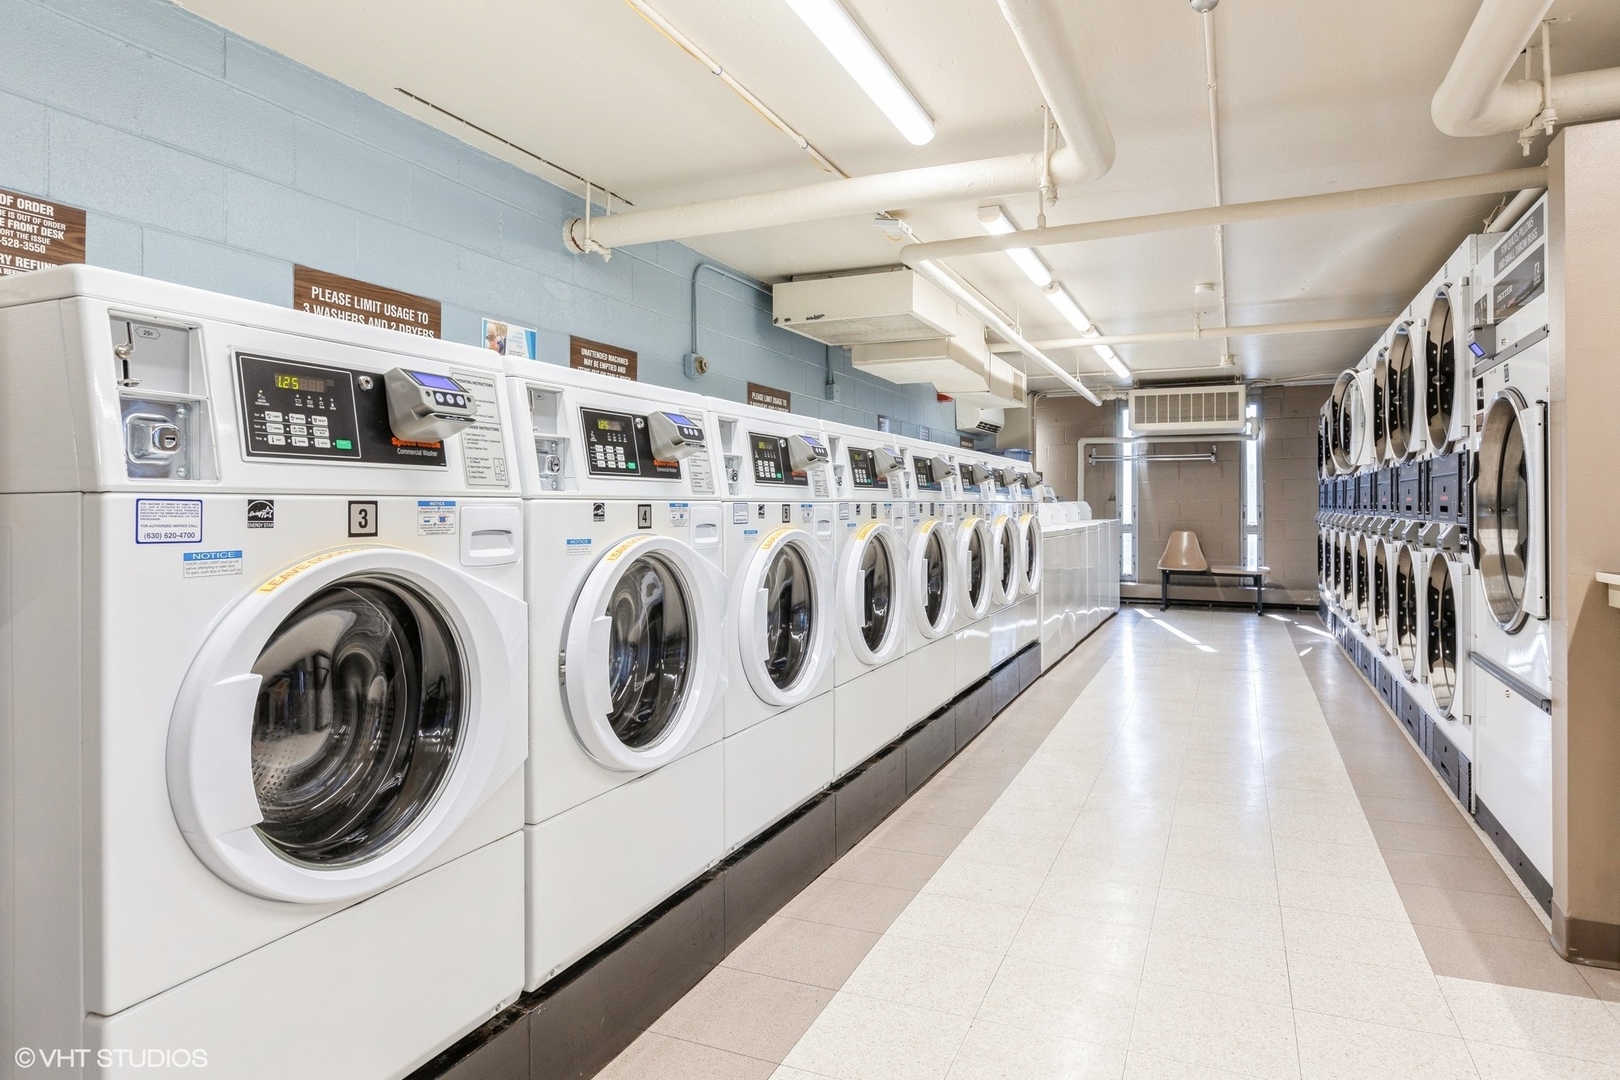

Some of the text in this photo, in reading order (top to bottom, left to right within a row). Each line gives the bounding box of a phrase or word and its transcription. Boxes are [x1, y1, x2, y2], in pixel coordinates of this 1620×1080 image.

[17, 198, 54, 216] ORDER
[8, 210, 15, 218] IS
[17, 213, 31, 222] OUT
[33, 216, 41, 225] OF
[44, 220, 66, 230] ORDER
[8, 219, 38, 234] FRONT
[41, 227, 64, 240] DESK
[16, 232, 29, 240] THE
[31, 235, 50, 245] ISSUE
[312, 286, 428, 324] PLEASE LIMIT USAGE TO
[304, 302, 310, 314] 3
[313, 304, 364, 324] WASHERS
[368, 316, 388, 330] AND
[390, 322, 396, 330] 2
[580, 348, 608, 360] UNATTENDED
[358, 508, 368, 528] 3
[642, 510, 648, 524] 4
[144, 532, 162, 540] (630)
[192, 551, 236, 560] NOTICE
[260, 564, 310, 592] LEAVE
